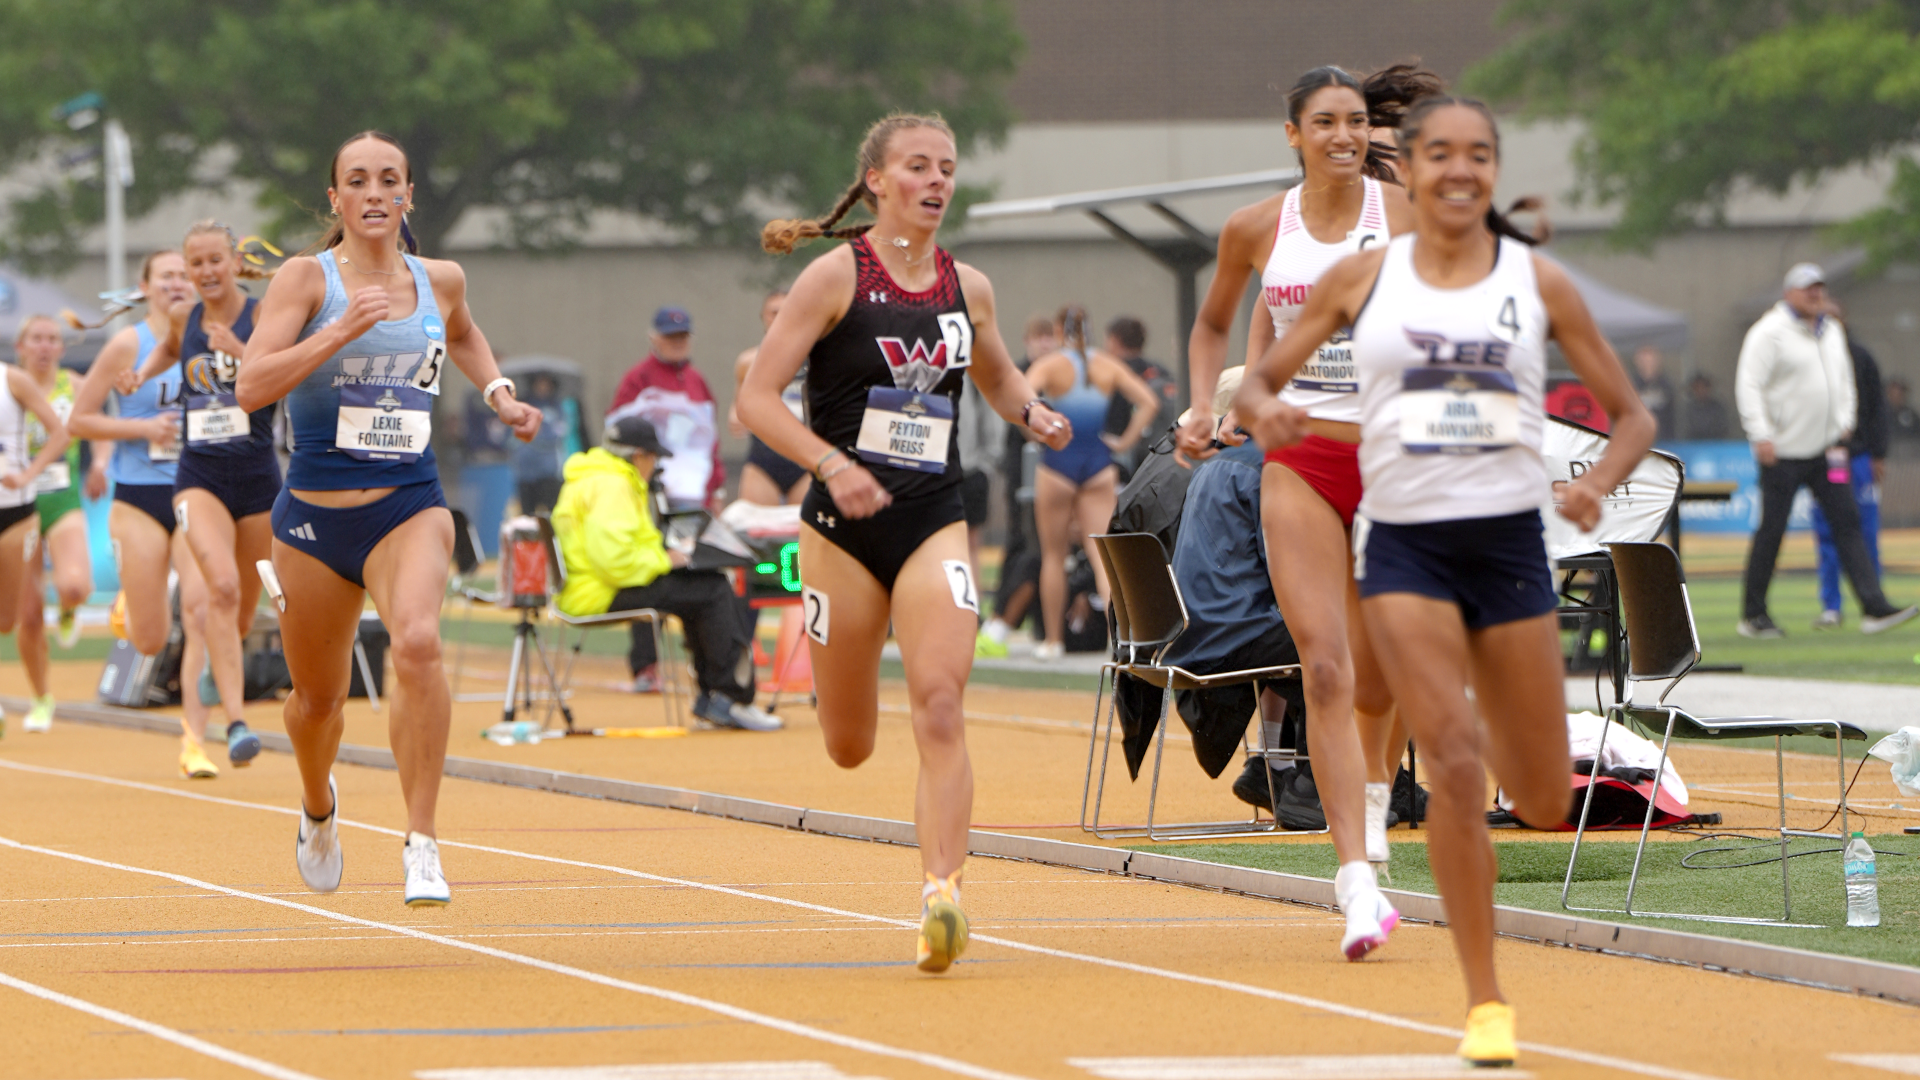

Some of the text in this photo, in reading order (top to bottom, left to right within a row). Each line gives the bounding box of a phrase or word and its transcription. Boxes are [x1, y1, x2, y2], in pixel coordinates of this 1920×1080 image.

[1265, 284, 1312, 307] SIMO
[1497, 295, 1521, 341] 4
[948, 319, 966, 364] 2
[1318, 348, 1352, 362] RAIYA
[419, 347, 443, 388] 5
[1445, 401, 1477, 418] ARIA
[372, 416, 402, 431] LEXIE
[888, 420, 931, 439] PEYTON
[1426, 421, 1494, 439] HAWKINS
[358, 432, 413, 448] FONTAINE
[889, 437, 925, 456] WEISS
[955, 565, 976, 607] 2
[809, 594, 822, 638] 2
